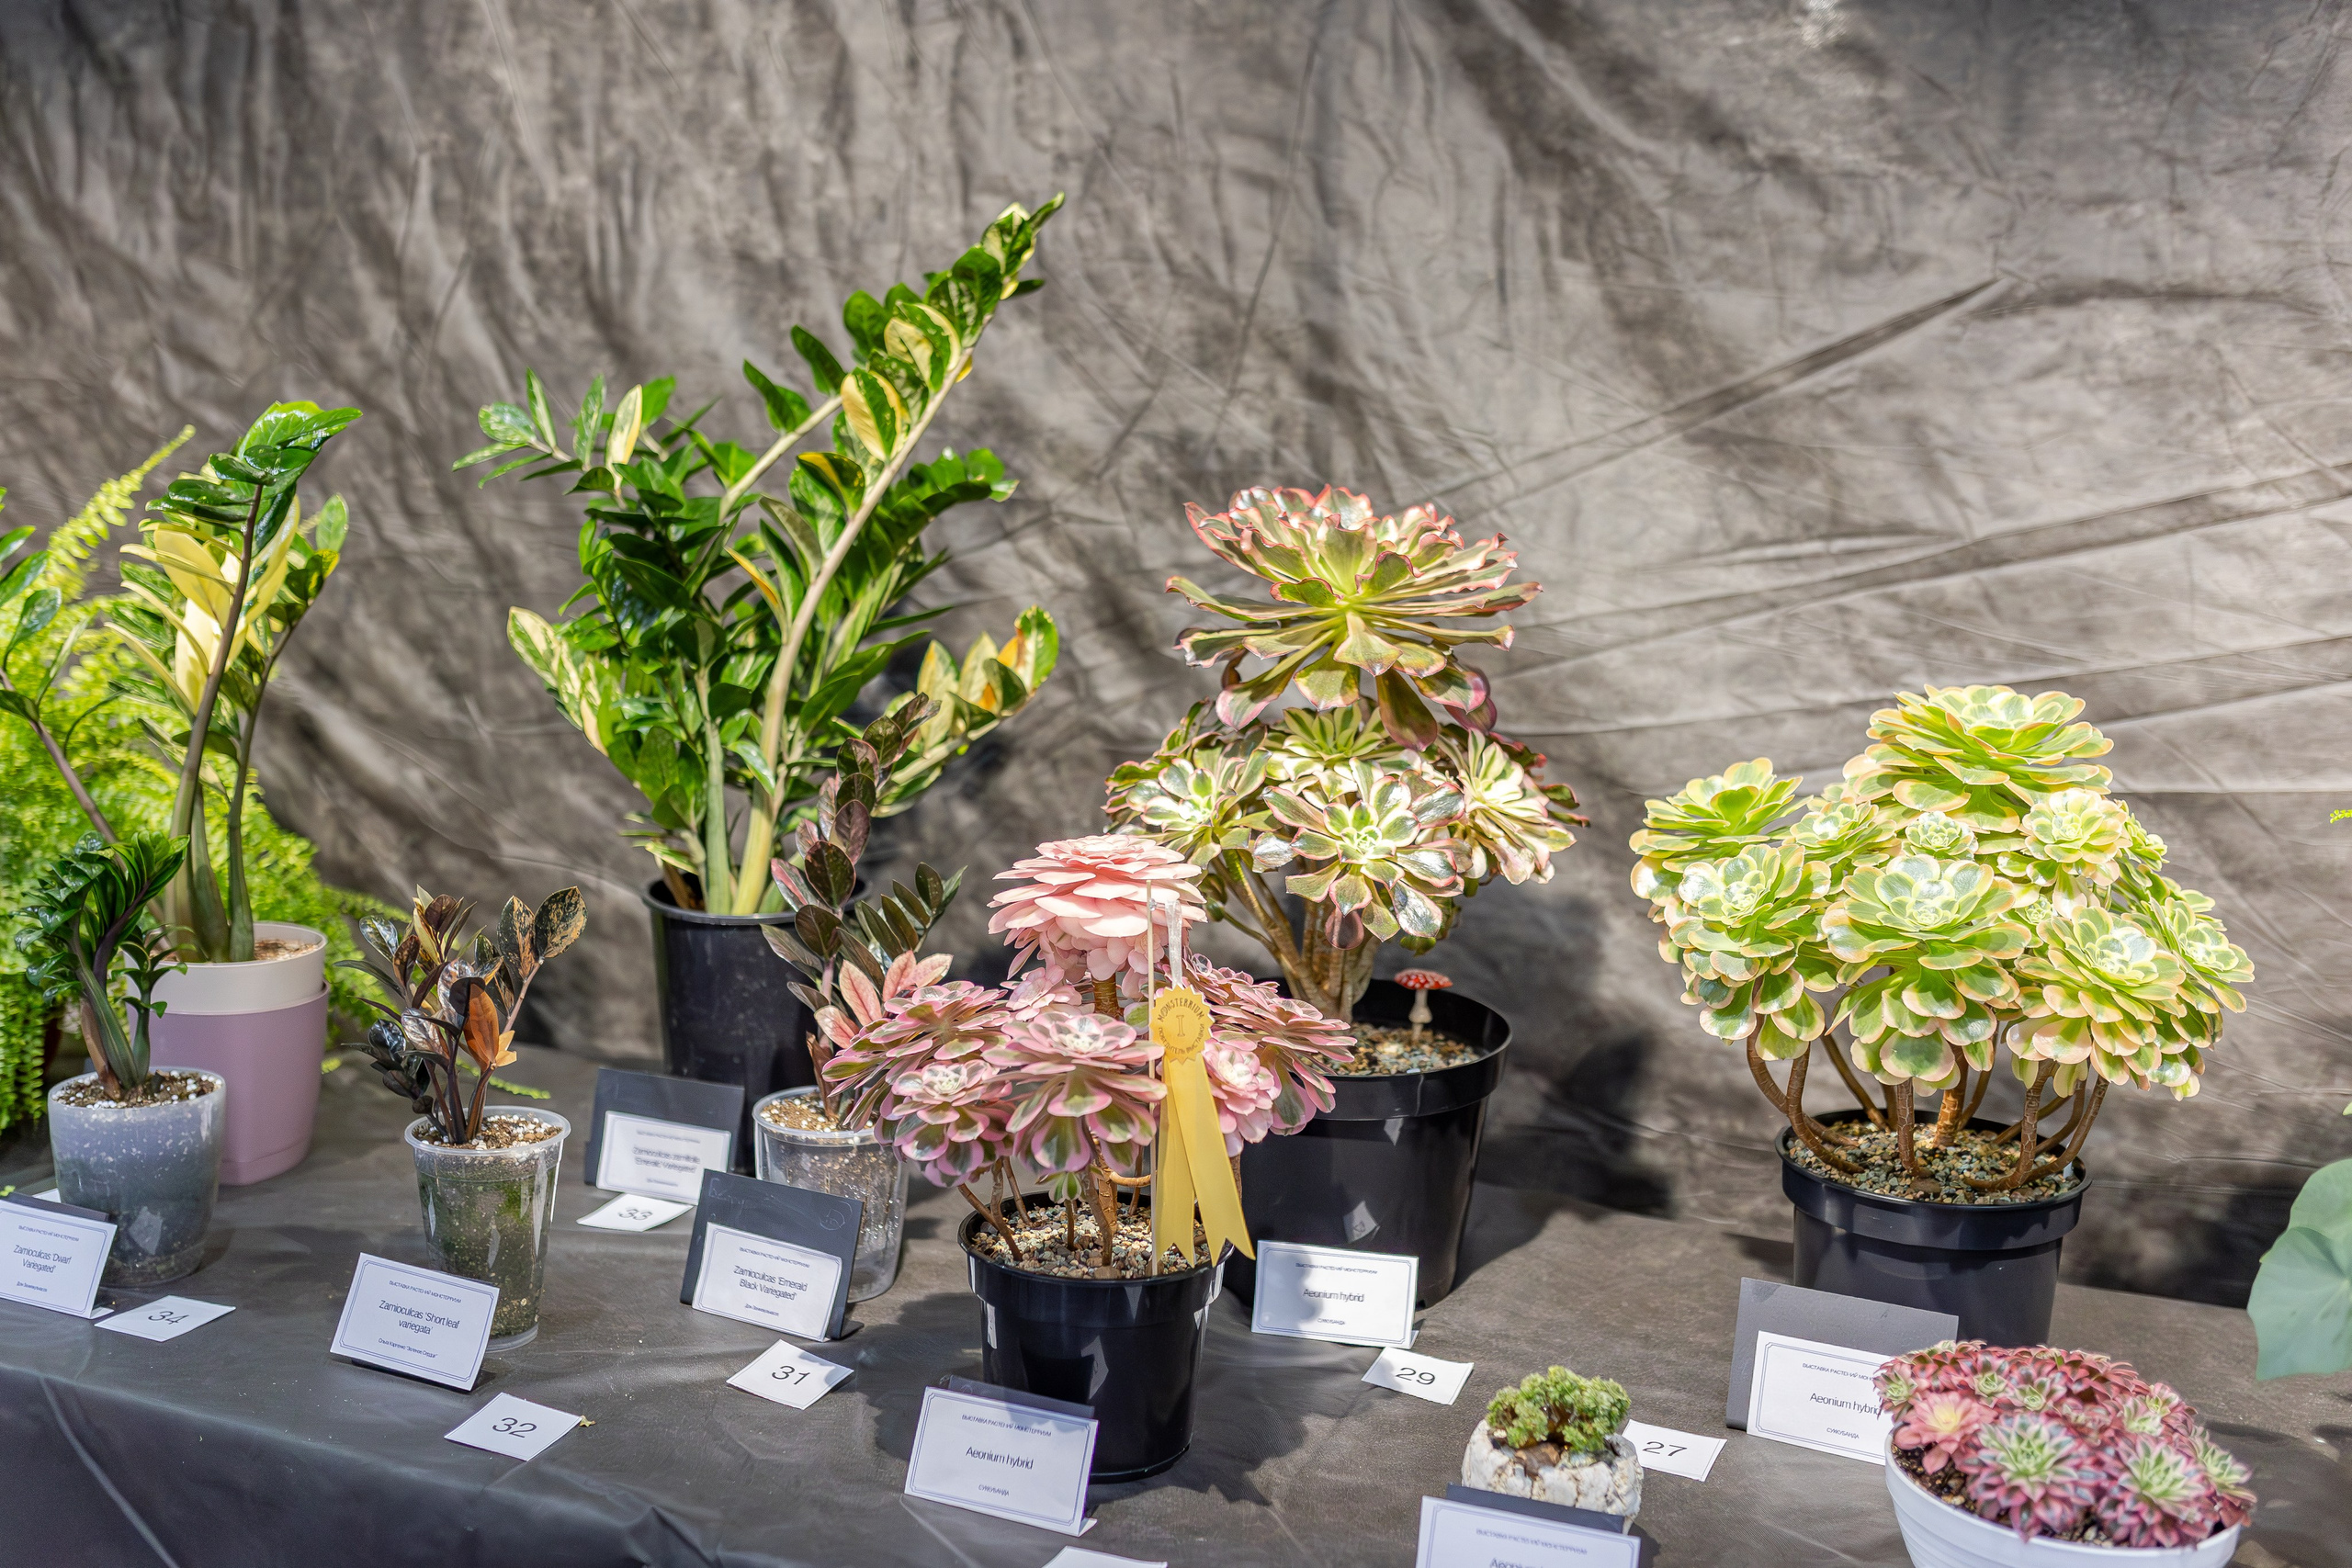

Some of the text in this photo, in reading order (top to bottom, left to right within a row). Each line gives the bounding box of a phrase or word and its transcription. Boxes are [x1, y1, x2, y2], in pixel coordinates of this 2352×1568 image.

[1158, 998, 1204, 1022] MONSTERRIUM
[616, 1207, 653, 1223] 33
[13, 1245, 51, 1260] Zamioculcas
[733, 1265, 776, 1283] Zamioculcas
[740, 1279, 758, 1291] Black
[1303, 1287, 1364, 1303] Aeonium hybrid
[148, 1311, 189, 1325] 34
[379, 1300, 424, 1319] Zamioculcas
[446, 1317, 460, 1329] leaf
[772, 1364, 810, 1386] 31
[1395, 1367, 1436, 1385] 29
[1803, 1363, 1829, 1372] ВЫСТАВКА
[1830, 1369, 1858, 1378] РАСТЕНИЙ
[1810, 1393, 1851, 1409] Aeonium
[492, 1417, 537, 1438] 32
[1642, 1441, 1687, 1457] 27
[966, 1447, 1034, 1470] Aeonium hybrid
